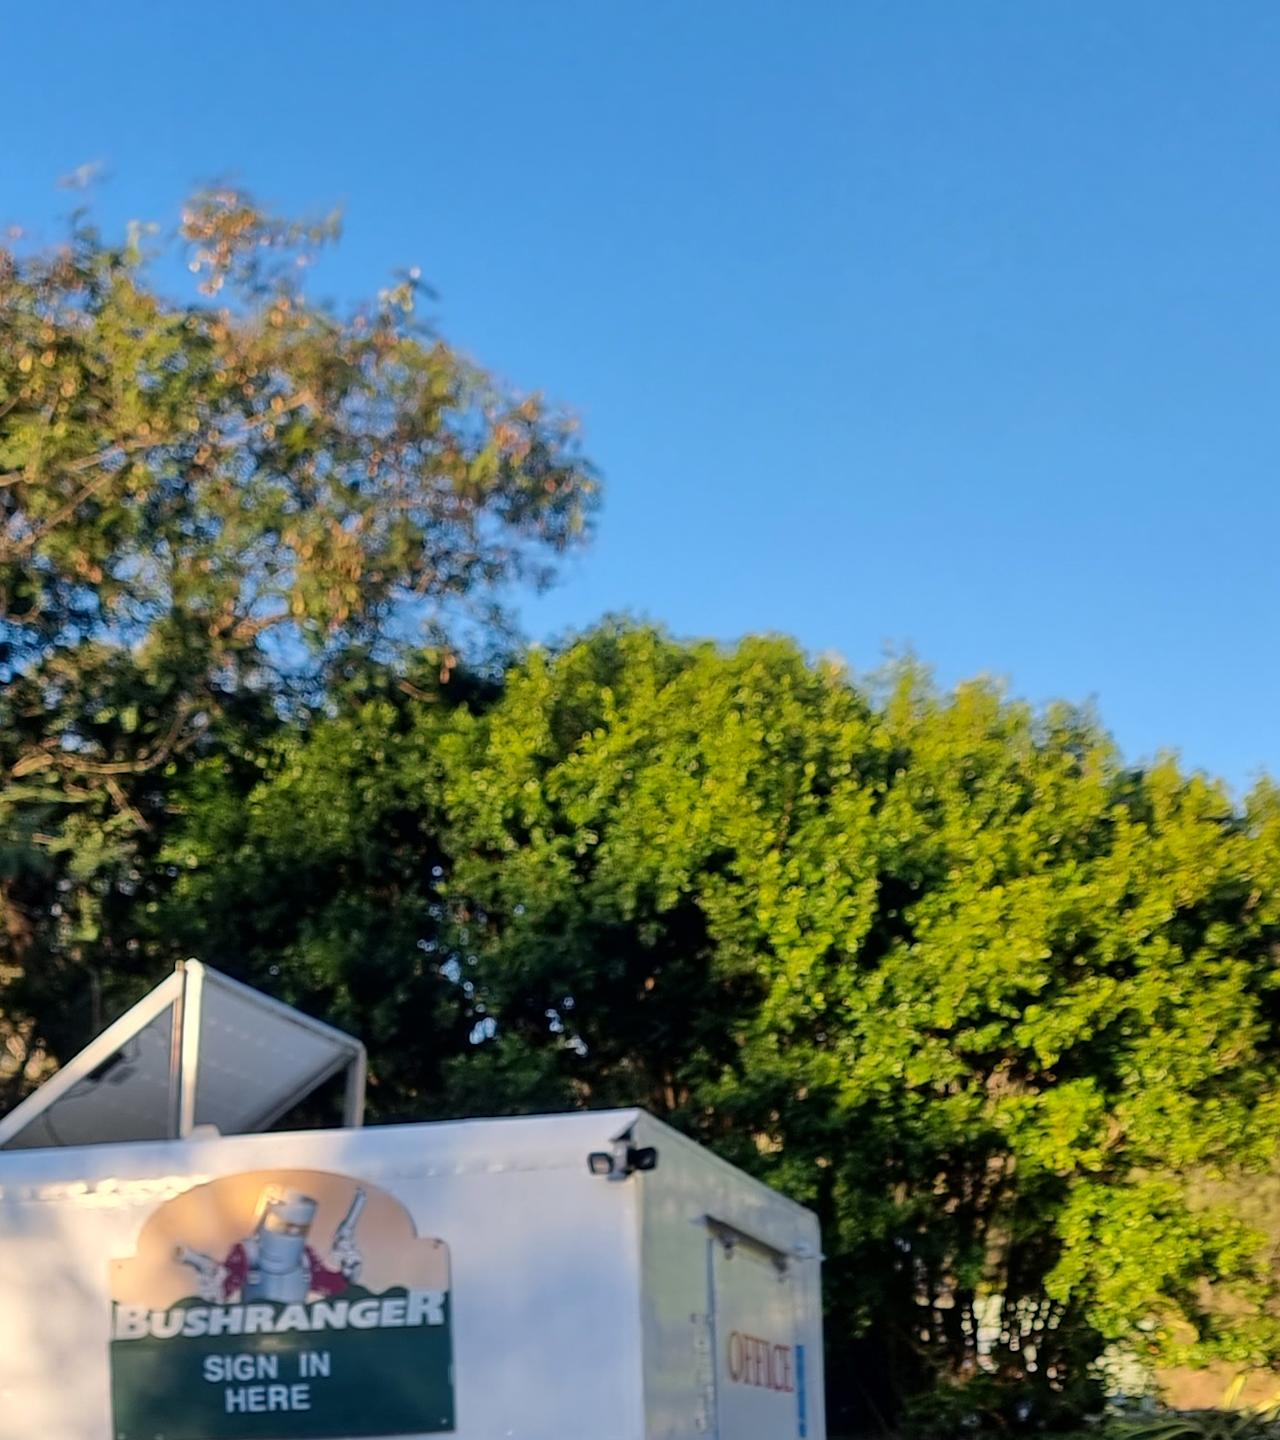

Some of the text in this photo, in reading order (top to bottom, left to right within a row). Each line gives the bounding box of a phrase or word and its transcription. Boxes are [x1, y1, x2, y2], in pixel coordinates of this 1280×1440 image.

[113, 1289, 446, 1341] BUSHRANGER
[203, 1351, 331, 1383] SIGN IN
[728, 1330, 795, 1393] OFFICE
[224, 1383, 312, 1414] HERE
